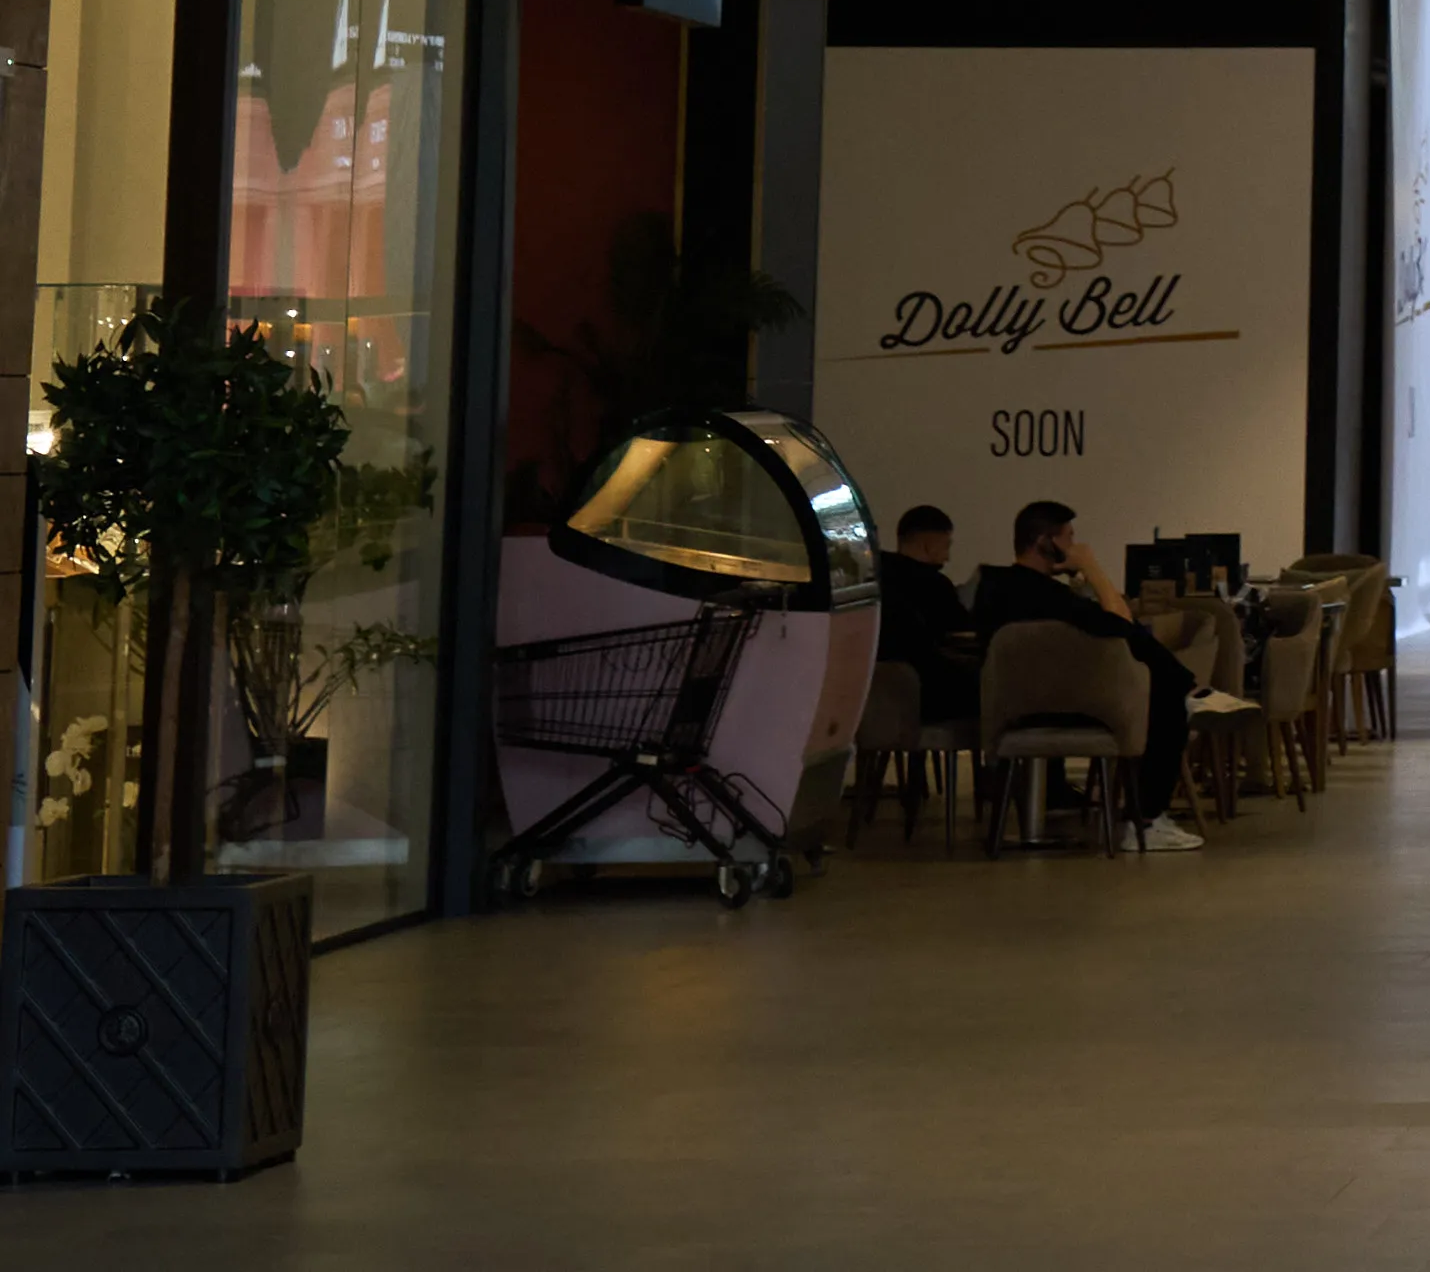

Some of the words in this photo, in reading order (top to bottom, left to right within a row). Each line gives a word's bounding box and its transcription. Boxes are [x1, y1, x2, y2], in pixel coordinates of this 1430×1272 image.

[880, 283, 1045, 355] Dolly
[1059, 273, 1182, 336] Bell
[989, 408, 1085, 458] SOON
